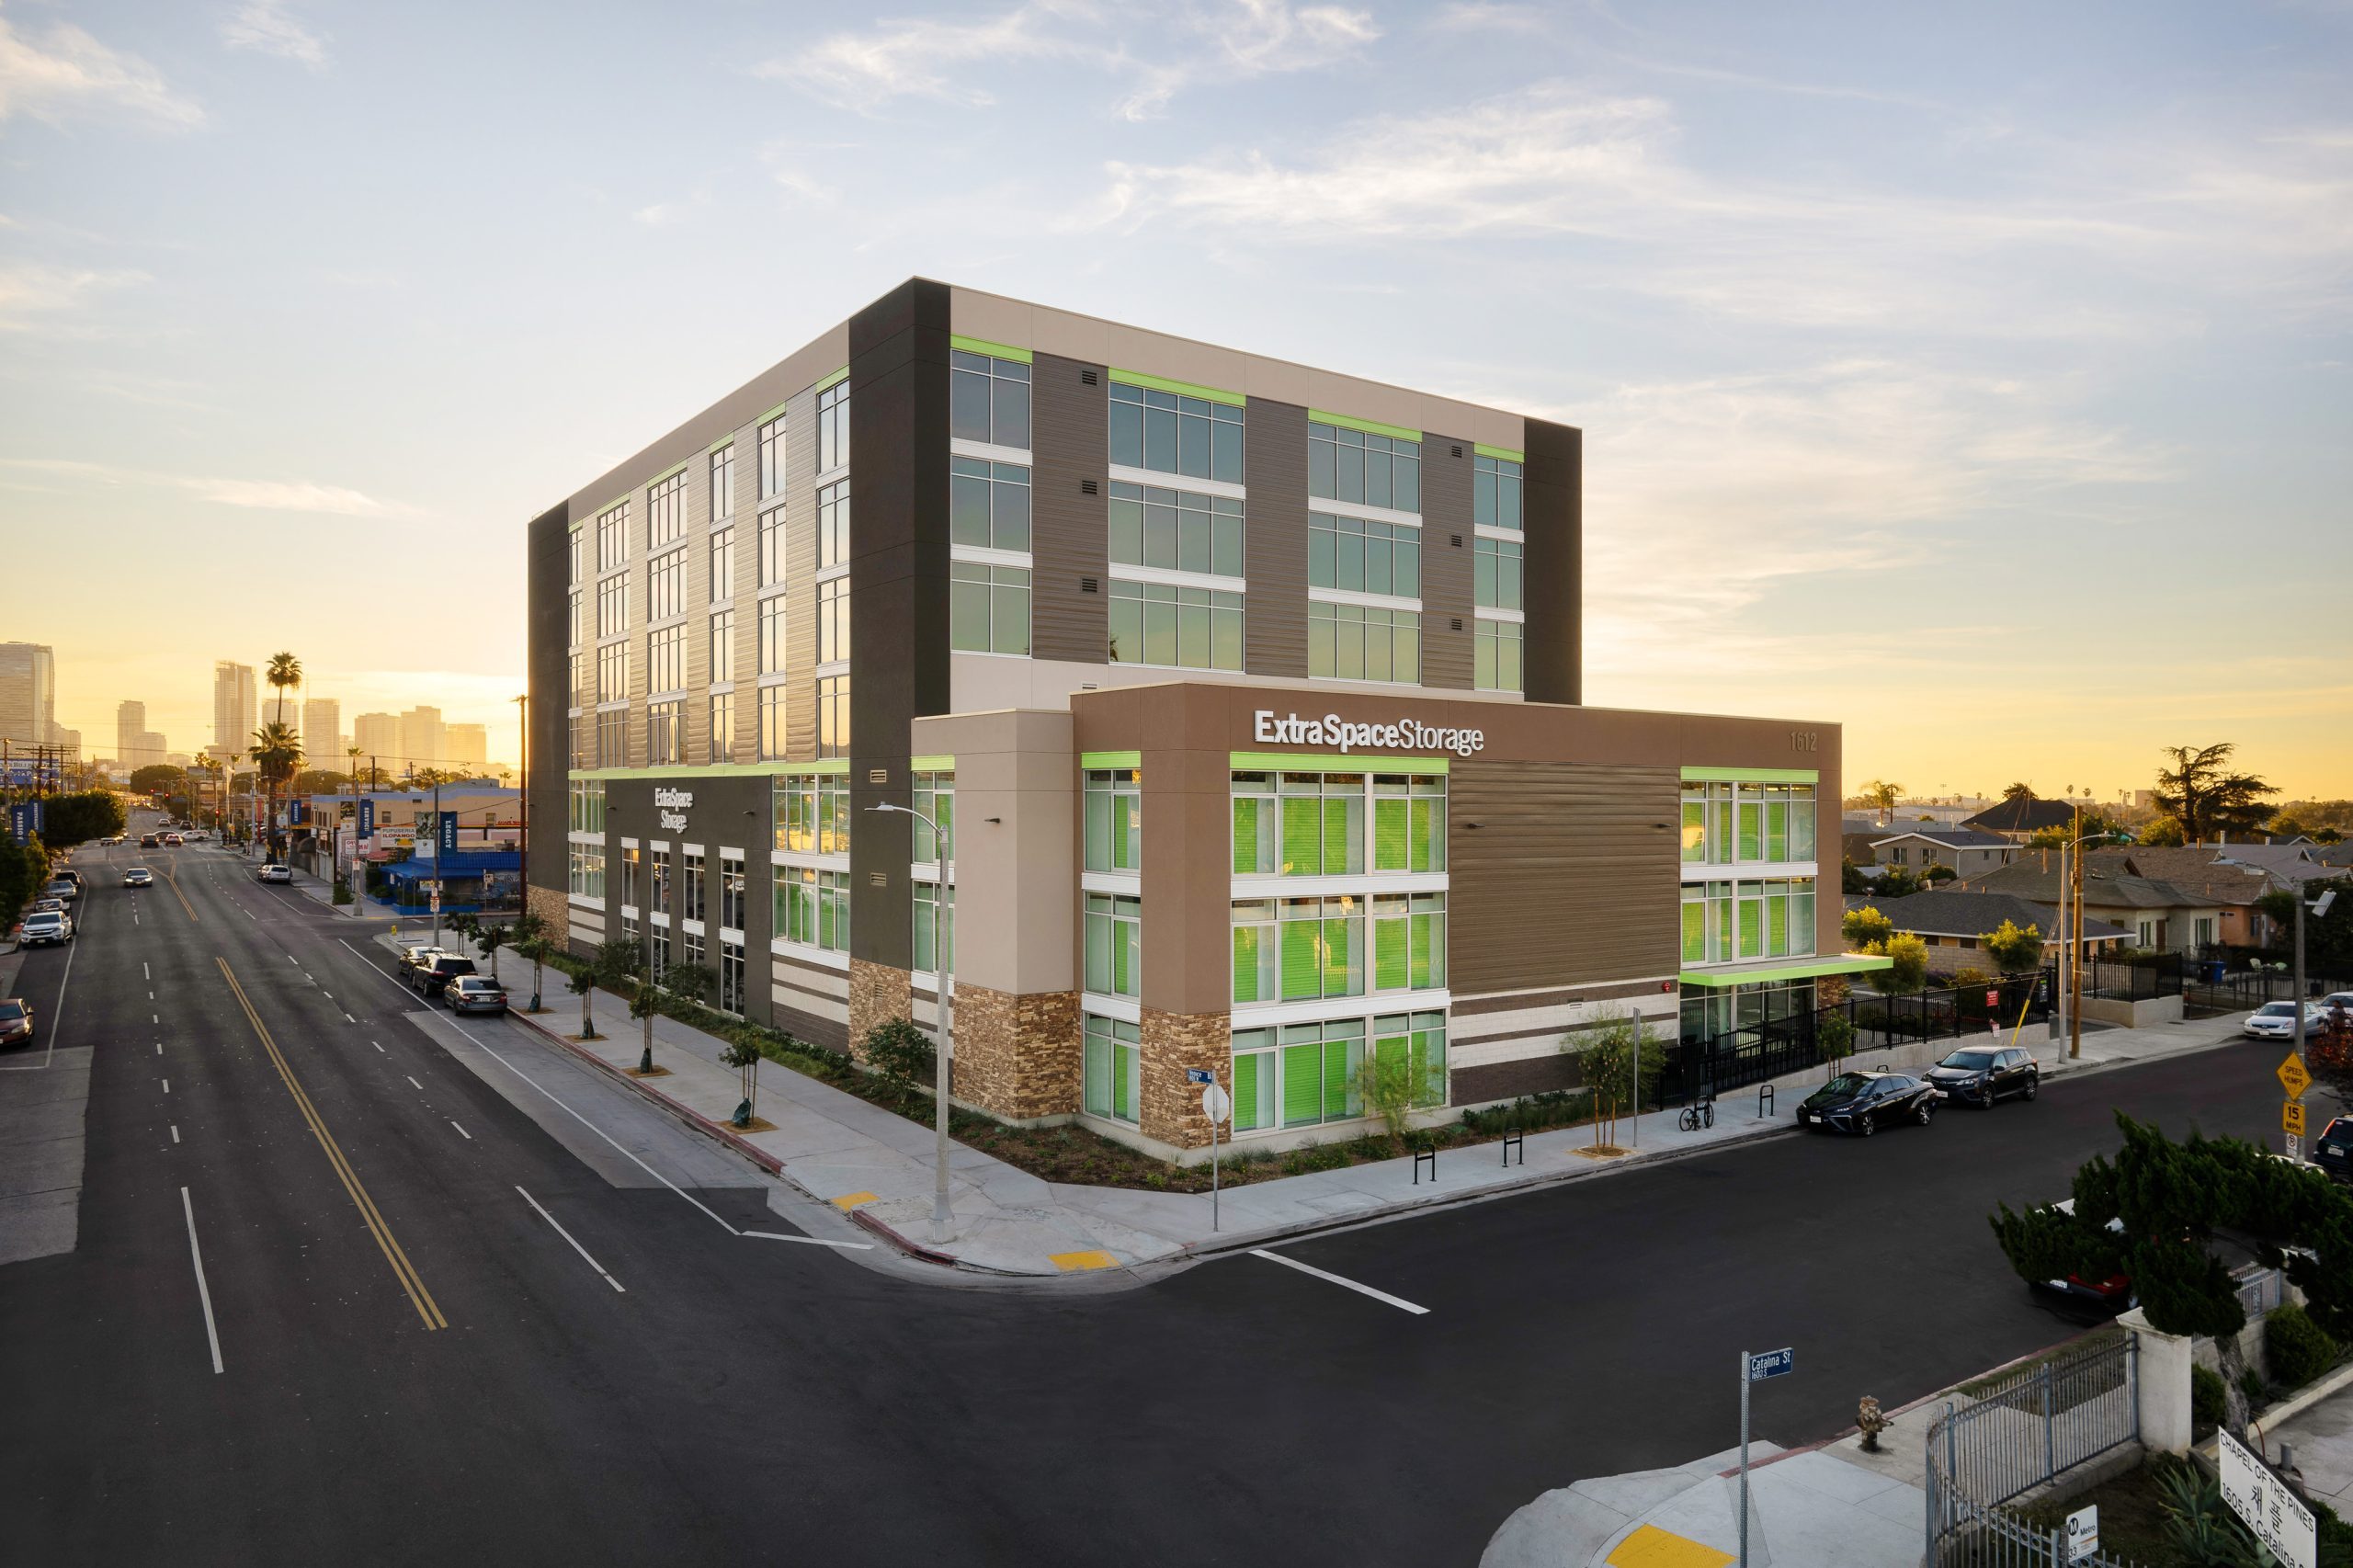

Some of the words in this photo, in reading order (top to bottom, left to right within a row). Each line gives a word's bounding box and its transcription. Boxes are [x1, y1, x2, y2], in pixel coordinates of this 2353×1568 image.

[1790, 732, 1817, 752] 1612
[654, 787, 693, 812] ExtraSpace
[660, 809, 688, 835] Storage
[2284, 1075, 2303, 1086] HUMPS
[2285, 1066, 2302, 1076] SPEED
[2288, 1106, 2300, 1120] 15
[2285, 1121, 2302, 1131] MPH
[1751, 1356, 1779, 1371] Catalina
[1782, 1351, 1791, 1364] St
[2220, 1433, 2253, 1472] CHAPEL
[2255, 1465, 2268, 1483] OF
[2268, 1478, 2286, 1506] THE
[2288, 1498, 2314, 1533] PINES
[2080, 1525, 2096, 1536] Metro
[2222, 1482, 2244, 1516] 1605
[2245, 1507, 2254, 1528] S.
[2256, 1519, 2296, 1568] Catalina
